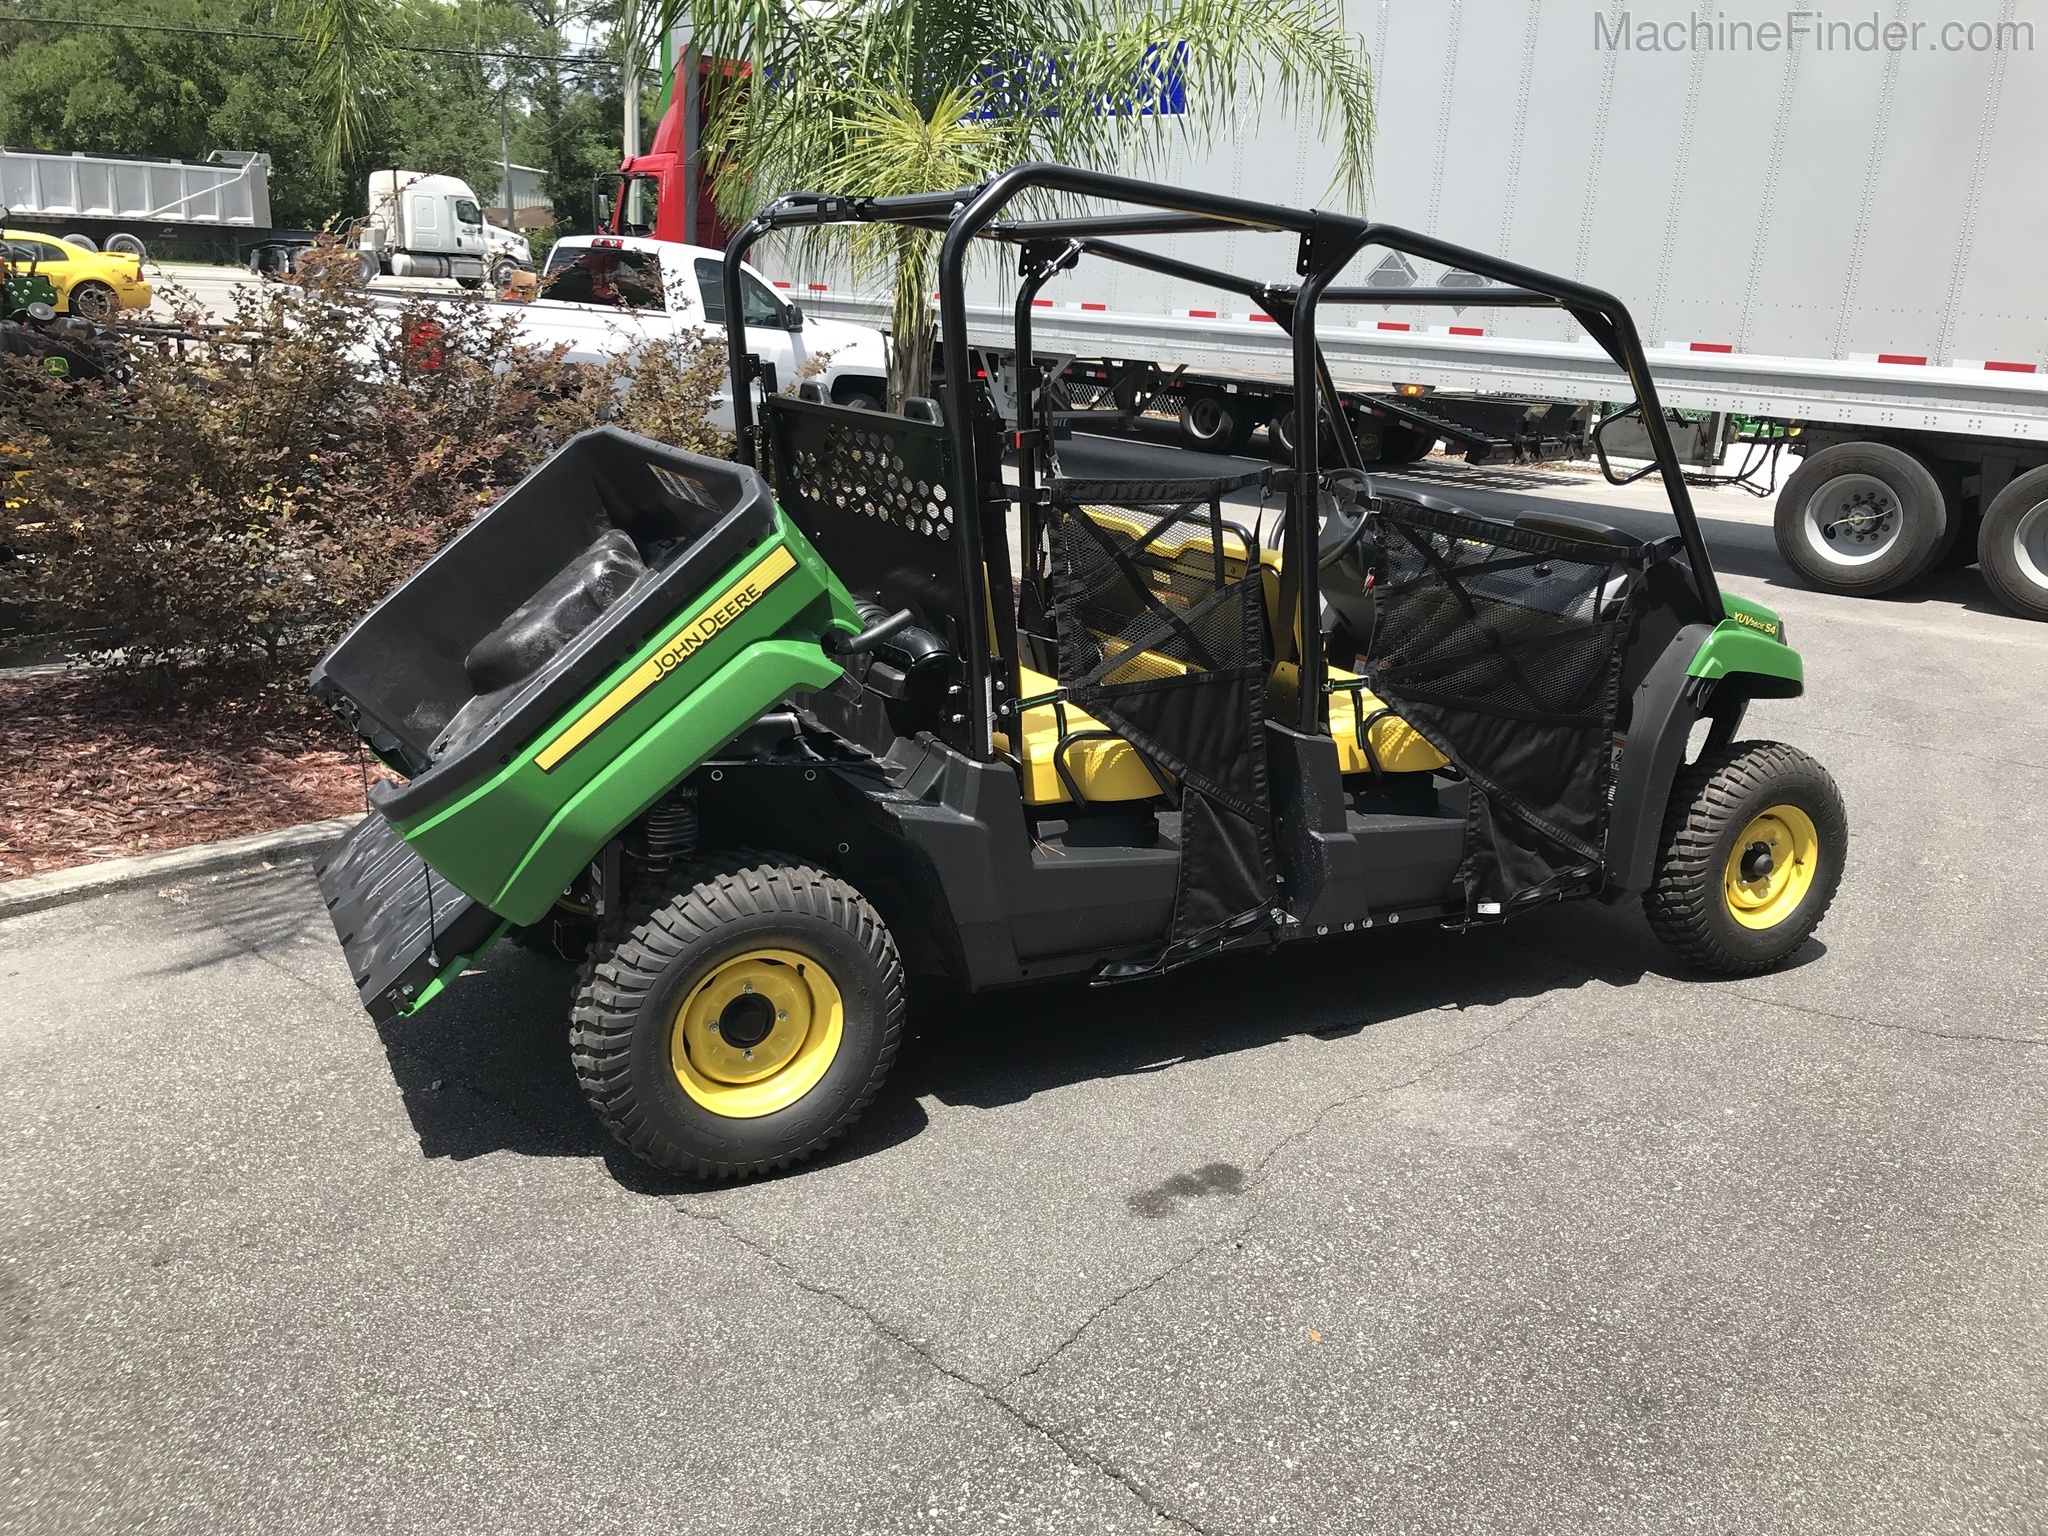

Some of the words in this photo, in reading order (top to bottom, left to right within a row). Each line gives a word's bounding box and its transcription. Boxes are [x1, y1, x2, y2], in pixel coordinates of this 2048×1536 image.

[653, 631, 702, 678] JOHN
[698, 583, 761, 636] DEERE
[1764, 623, 1776, 634] S4
